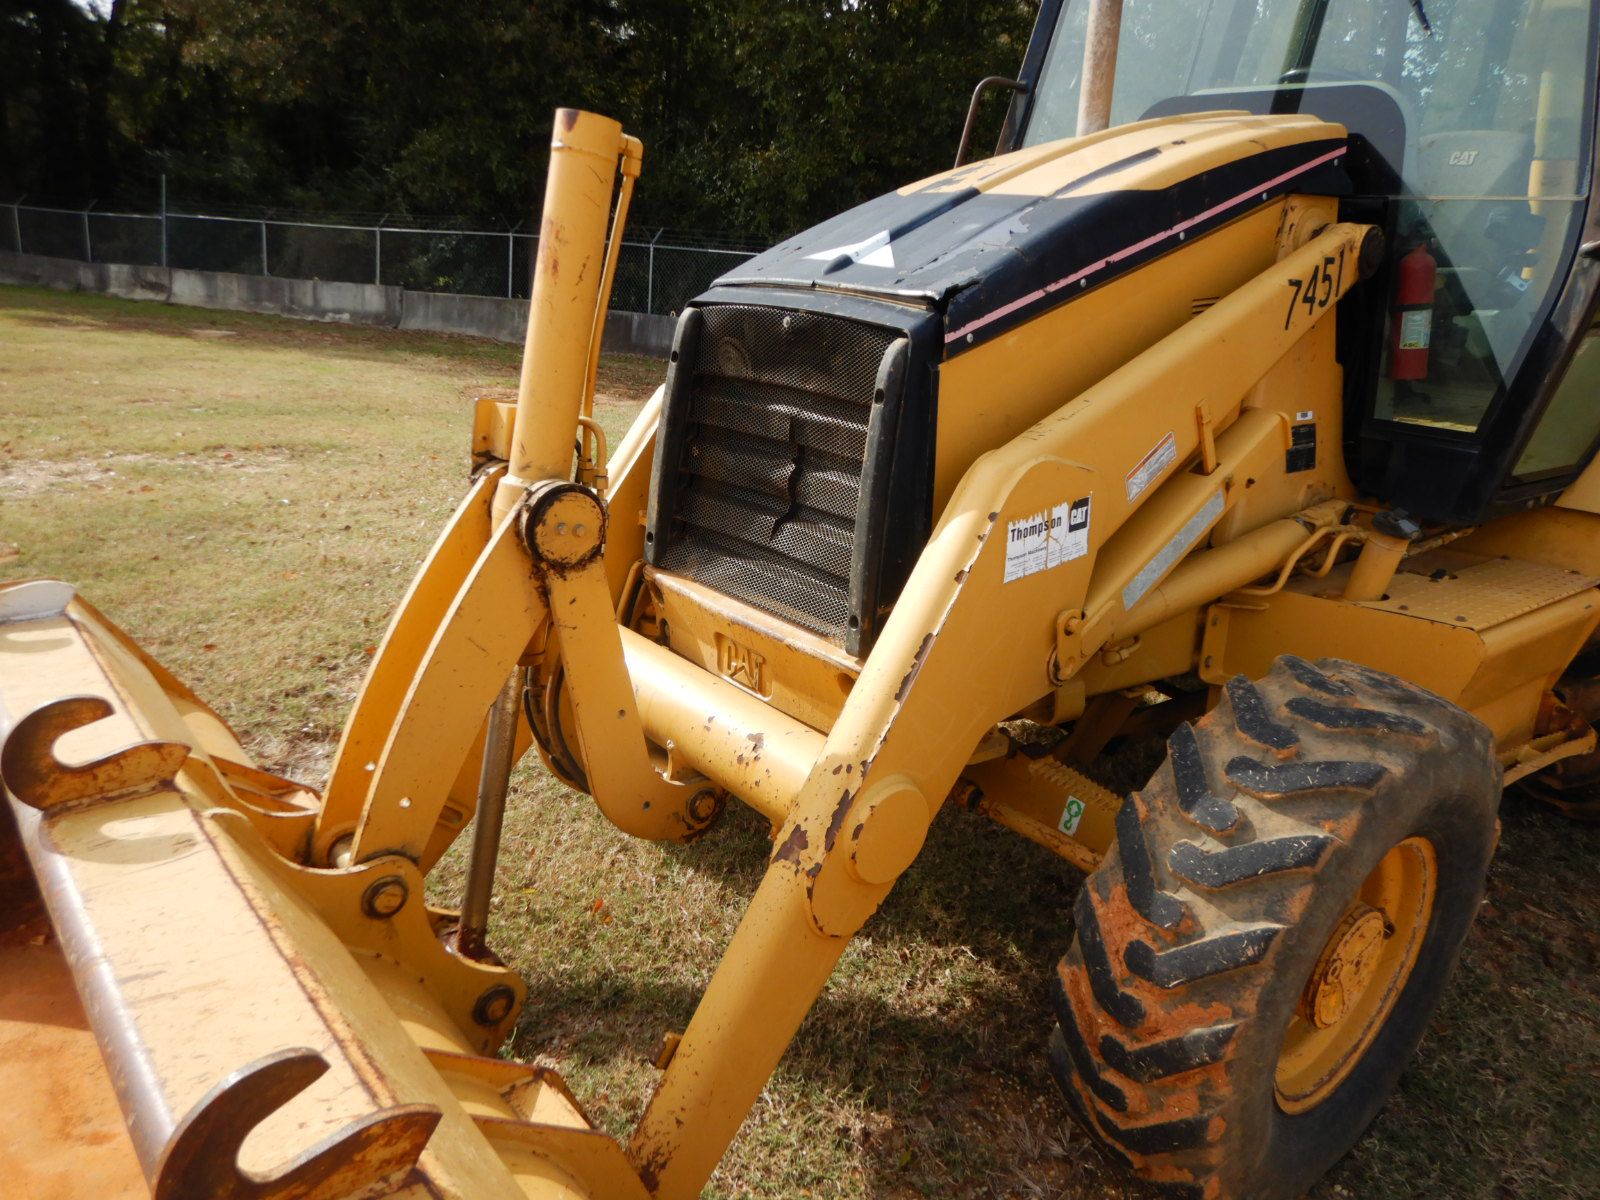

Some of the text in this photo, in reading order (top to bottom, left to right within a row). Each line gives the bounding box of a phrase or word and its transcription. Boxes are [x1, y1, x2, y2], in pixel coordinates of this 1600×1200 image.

[1448, 151, 1479, 166] CAT
[1285, 246, 1345, 331] 7451
[1011, 516, 1062, 542] Thompson
[718, 637, 767, 695] CAT
